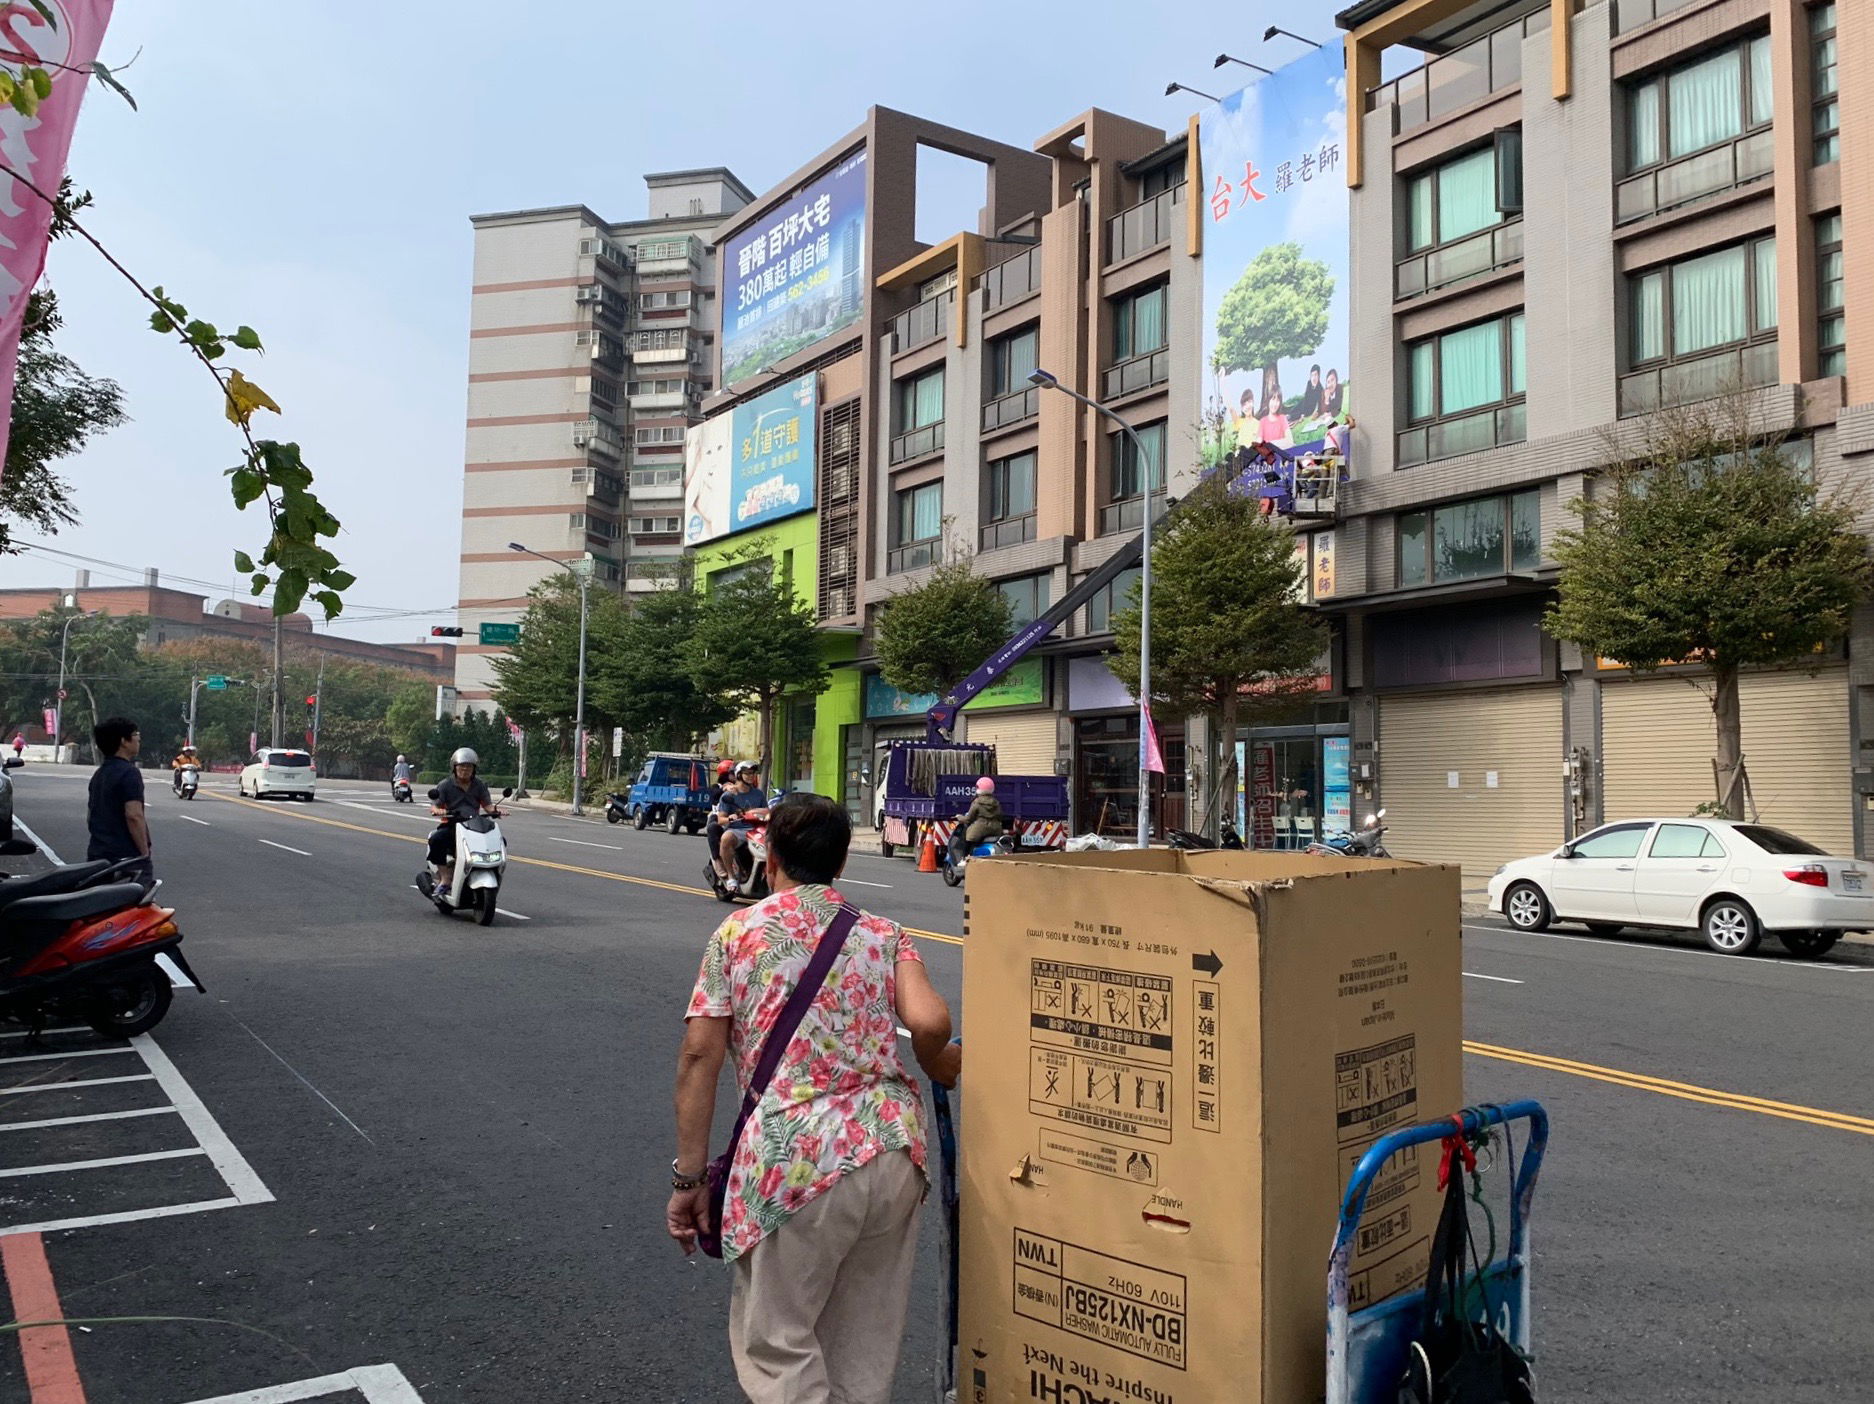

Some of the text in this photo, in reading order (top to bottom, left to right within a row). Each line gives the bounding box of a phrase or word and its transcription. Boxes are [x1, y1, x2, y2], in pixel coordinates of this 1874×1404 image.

[1211, 143, 1338, 222] 台大 羅老師
[769, 194, 830, 259] 百坪大宅
[738, 259, 787, 310] 380萬起
[790, 232, 829, 278] 輕自備
[1319, 535, 1330, 592] 羅老師
[945, 786, 976, 796] AAH35
[1137, 942, 1178, 956] 外包裝尺寸
[1198, 991, 1214, 1122] 這一邊比較重
[1151, 1194, 1183, 1209] HANDLE
[1018, 1238, 1057, 1267] TWN
[1108, 1276, 1180, 1308] 110V 60Hz
[1066, 1286, 1181, 1344] BD-NX125BJ
[1066, 1313, 1181, 1362] FULLY AUTOMATIC WASHER
[1023, 1344, 1063, 1373] Next
[1070, 1360, 1098, 1386] the
